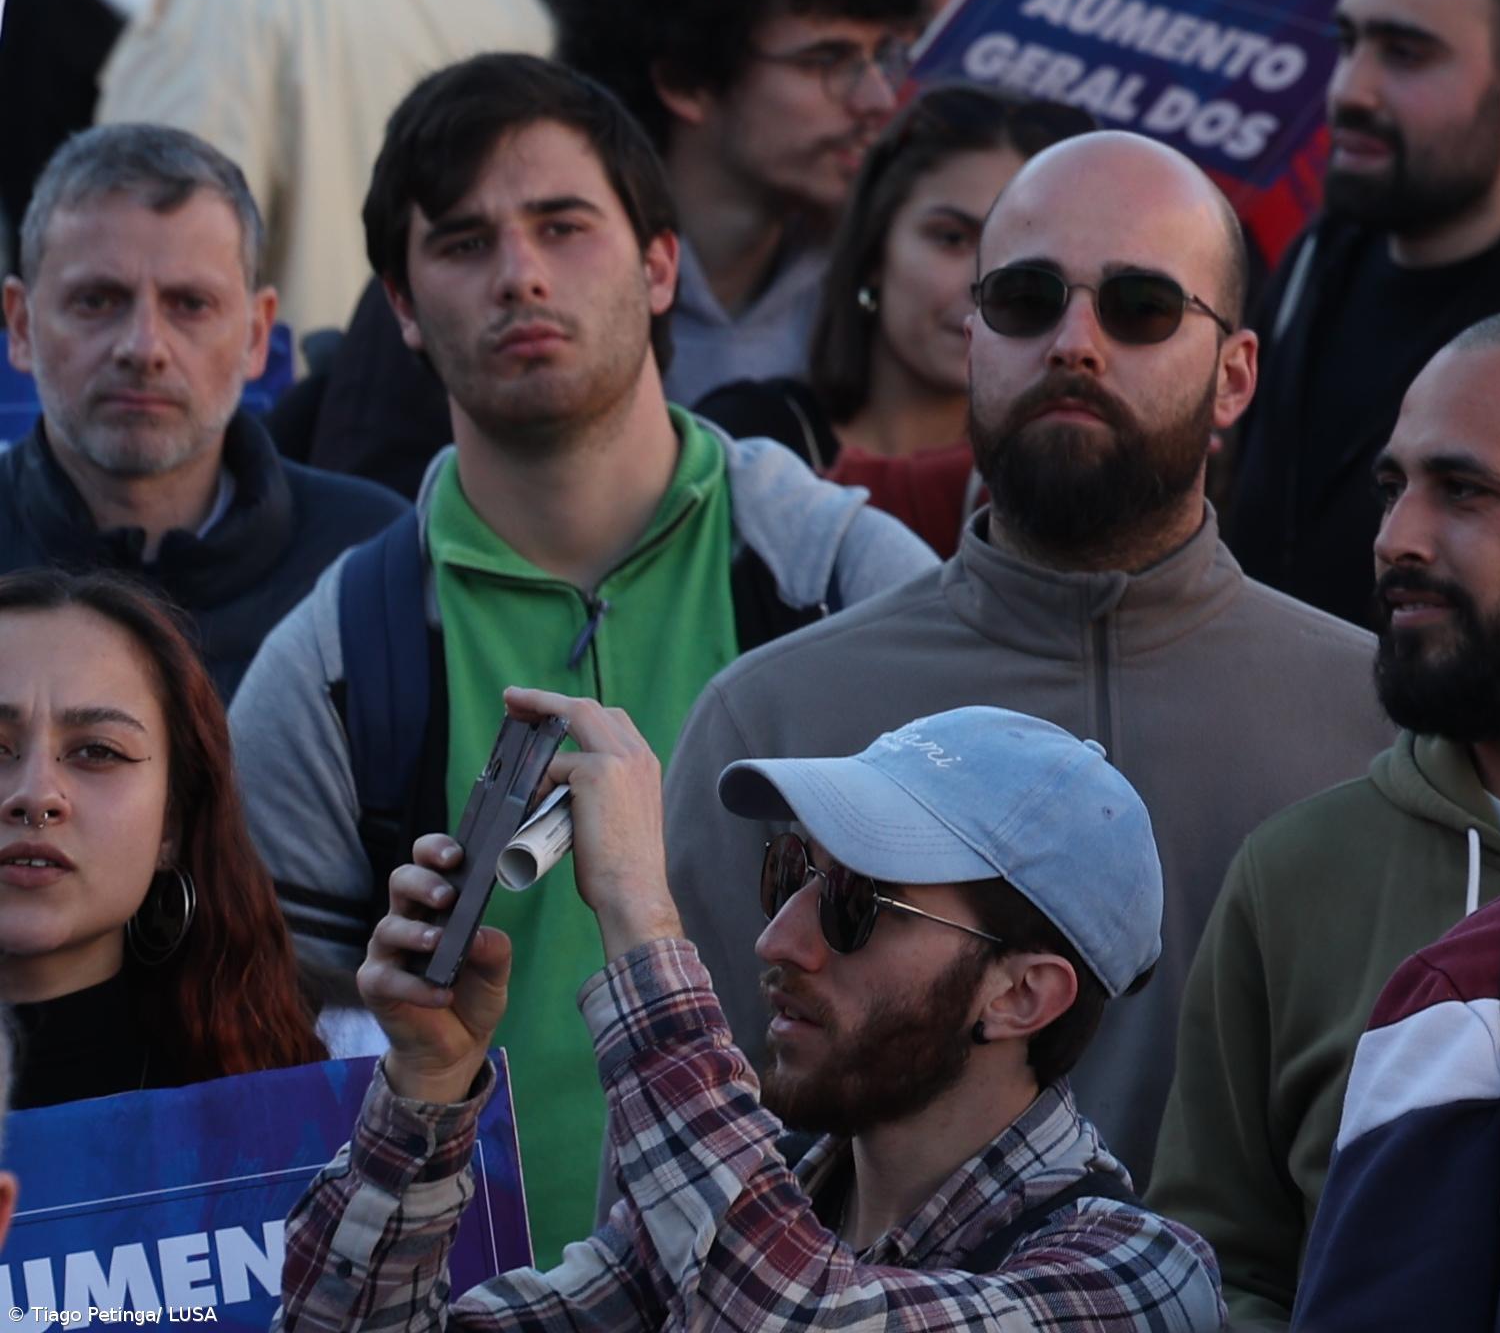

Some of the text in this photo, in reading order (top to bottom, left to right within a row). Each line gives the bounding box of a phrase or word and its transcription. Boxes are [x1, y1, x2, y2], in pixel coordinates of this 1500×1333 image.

[963, 33, 1280, 160] GERAL DOS
[0, 1219, 286, 1333] UMEN
